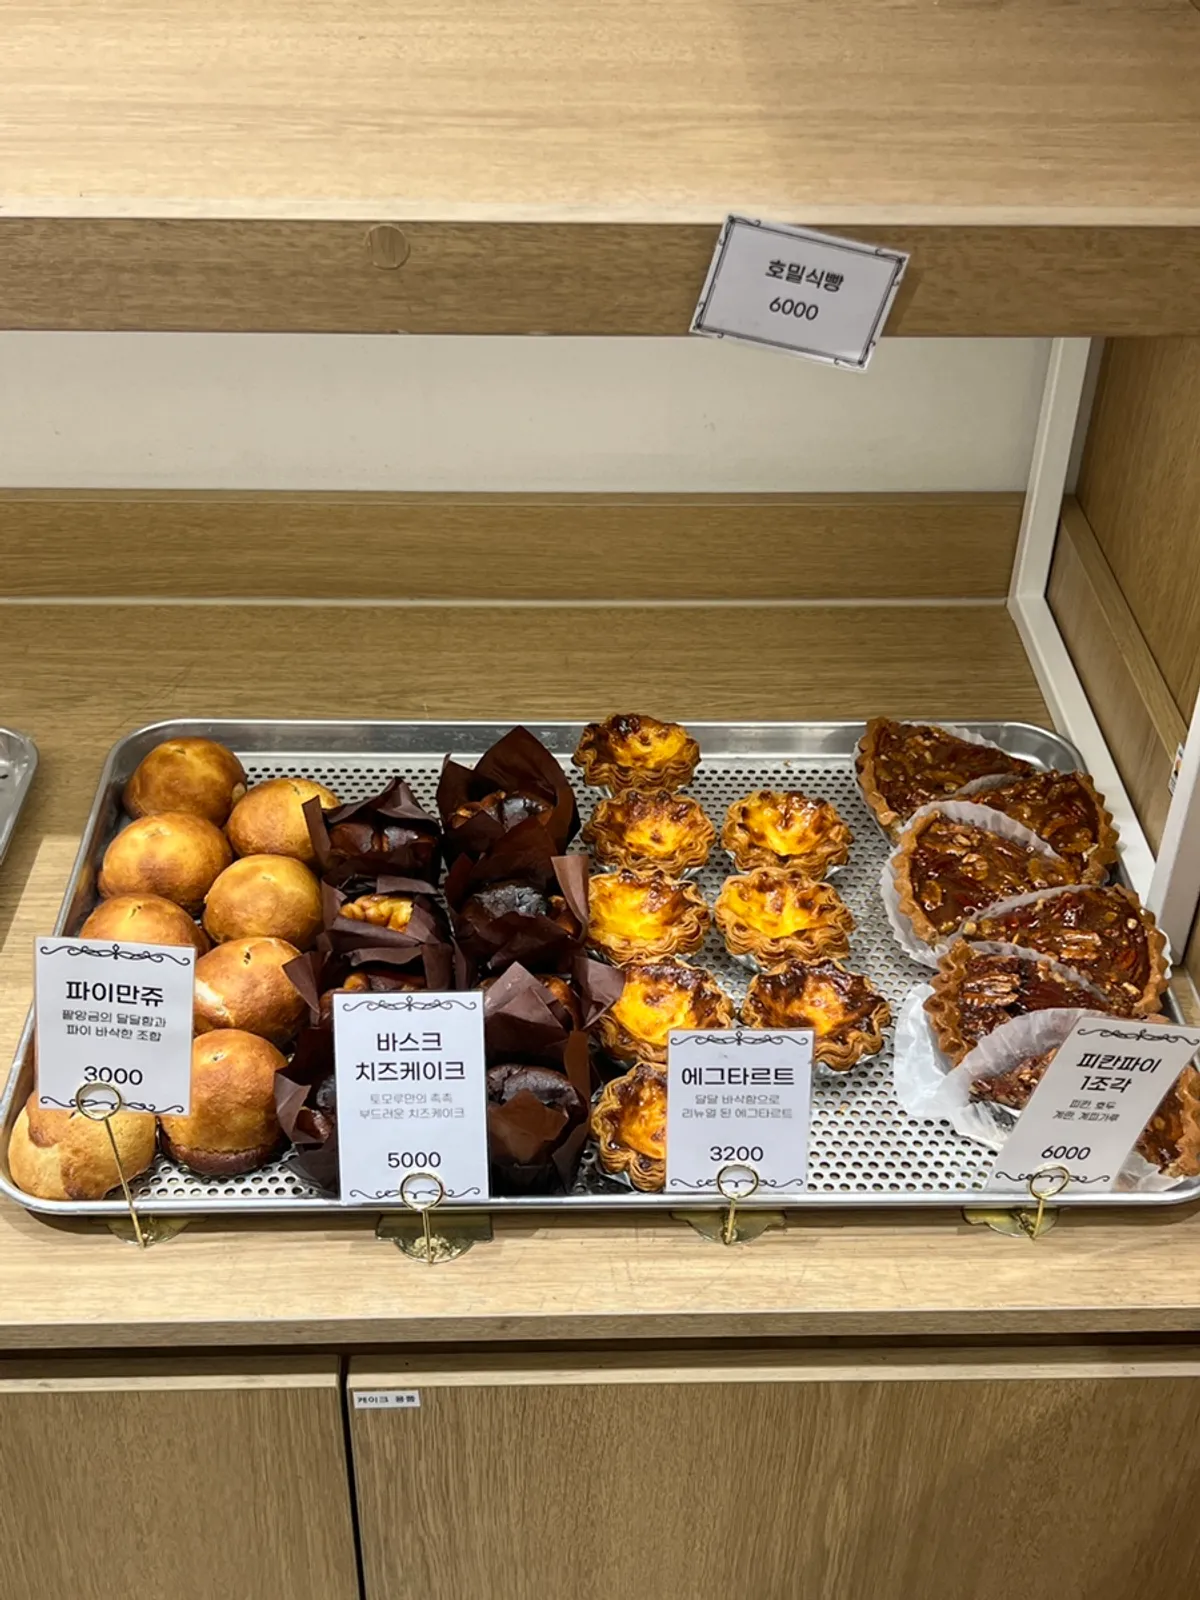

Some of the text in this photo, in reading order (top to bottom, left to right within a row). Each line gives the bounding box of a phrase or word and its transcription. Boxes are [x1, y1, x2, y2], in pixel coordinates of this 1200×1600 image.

[765, 259, 844, 292] 호밀식빵
[769, 296, 819, 321] 6000
[66, 981, 164, 1007] 파이만쥬
[116, 1013, 167, 1028] 달달함과
[66, 1024, 162, 1042] 파이 바삭한 조합
[377, 1032, 443, 1052] 바스크
[355, 1061, 466, 1082] 치즈케이크
[1076, 1053, 1163, 1073] 피칸파이
[84, 1066, 143, 1086] 3000
[681, 1067, 795, 1086] 에그타르트
[1080, 1075, 1132, 1093] 1조각
[721, 1094, 780, 1105] 바삭함으로
[359, 1107, 465, 1120] 부드러운 치즈케이크
[681, 1108, 793, 1119] 리뉴얼 된 에그타르트
[387, 1151, 441, 1168] 5000
[710, 1146, 764, 1162] 3200
[1041, 1146, 1091, 1161] 6000
[357, 1395, 389, 1404] 케이크
